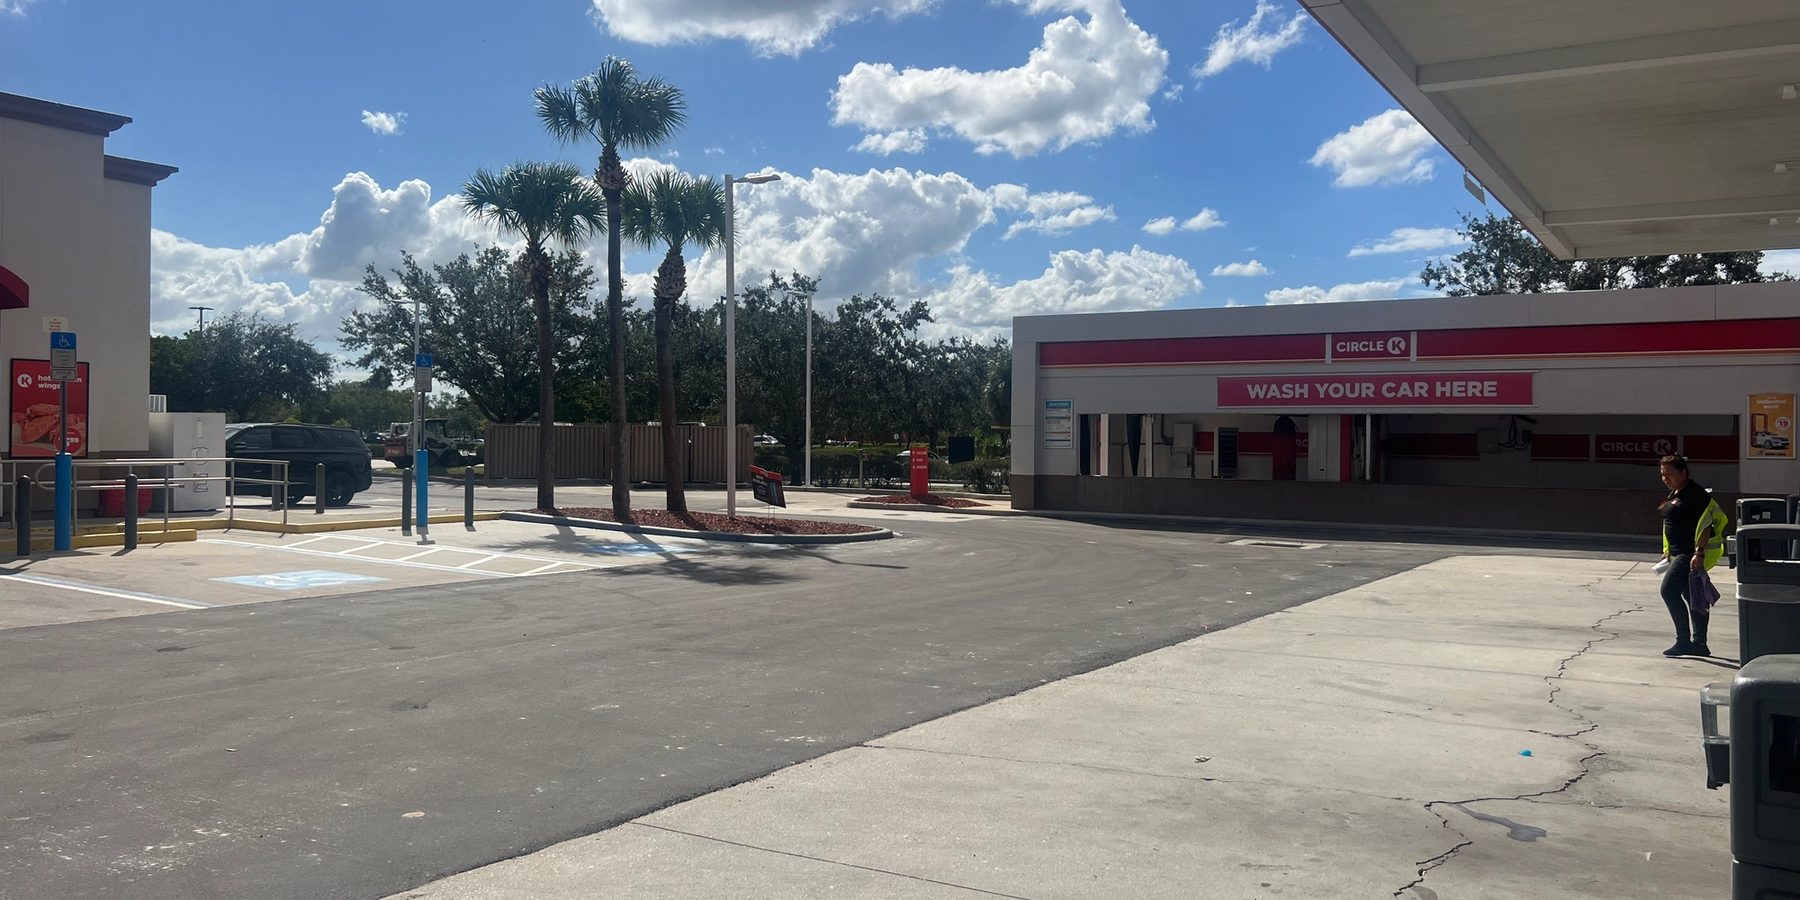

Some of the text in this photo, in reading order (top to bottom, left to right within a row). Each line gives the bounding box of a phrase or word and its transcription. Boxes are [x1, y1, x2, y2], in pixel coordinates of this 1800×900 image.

[1336, 337, 1406, 355] CIRCLE K
[17, 374, 32, 388] K
[37, 382, 61, 390] wings
[1247, 381, 1498, 399] WASH YOUR CAR HERE
[1601, 439, 1672, 455] CIRCLE K
